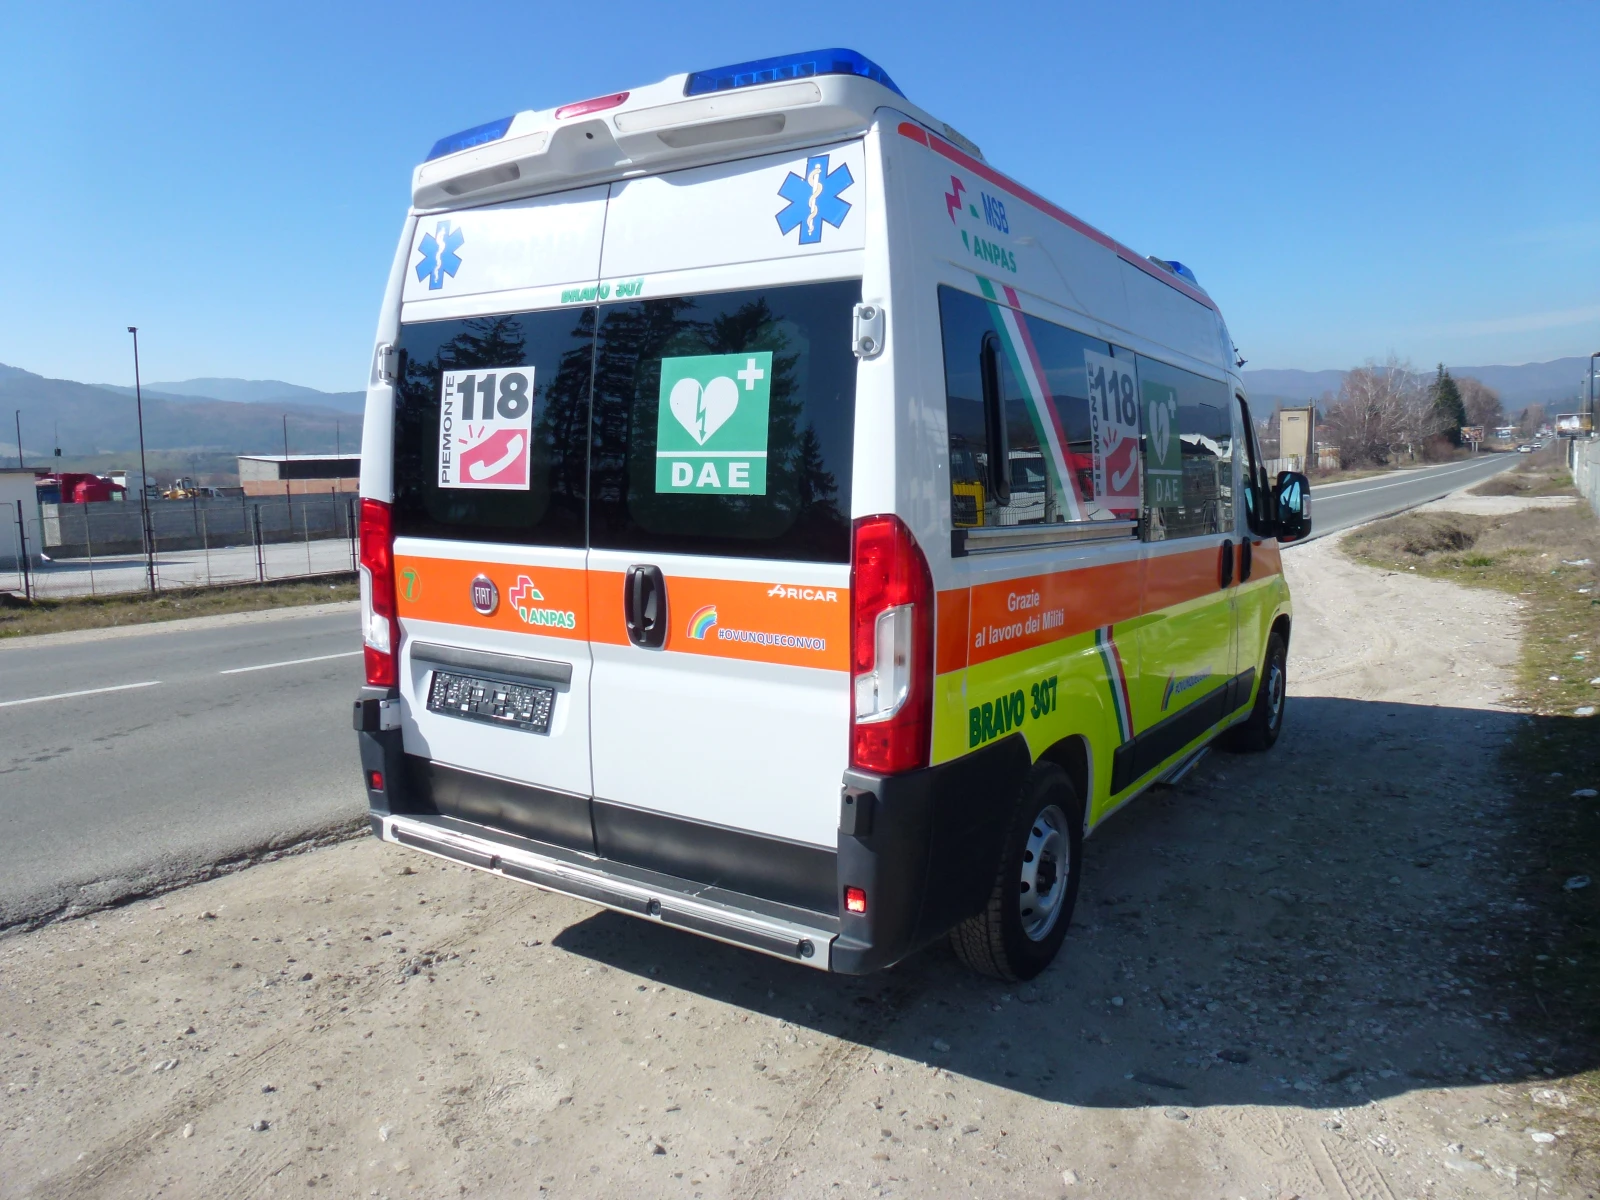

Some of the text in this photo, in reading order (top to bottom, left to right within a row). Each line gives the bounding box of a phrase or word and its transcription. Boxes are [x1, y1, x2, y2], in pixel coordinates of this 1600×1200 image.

[981, 191, 1009, 234] MSB
[974, 235, 1017, 273] ANPAS
[560, 278, 645, 303] BRAVO 307
[456, 372, 529, 420] 118
[1094, 365, 1137, 427] 118
[441, 375, 455, 484] PIEMONTE
[1087, 361, 1102, 497] PIEMONTE
[671, 461, 750, 488] DAE
[1155, 477, 1178, 503] DAE
[403, 571, 415, 599] 7
[474, 585, 491, 606] FIAT
[767, 584, 838, 602] ARICAR
[1007, 589, 1040, 612] Grazie
[528, 608, 576, 629] ANPAS
[974, 608, 1065, 648] al lavoro dei Militi
[718, 628, 826, 650] #OVUNQUECONVOI
[969, 675, 1058, 748] BRAVO 307
